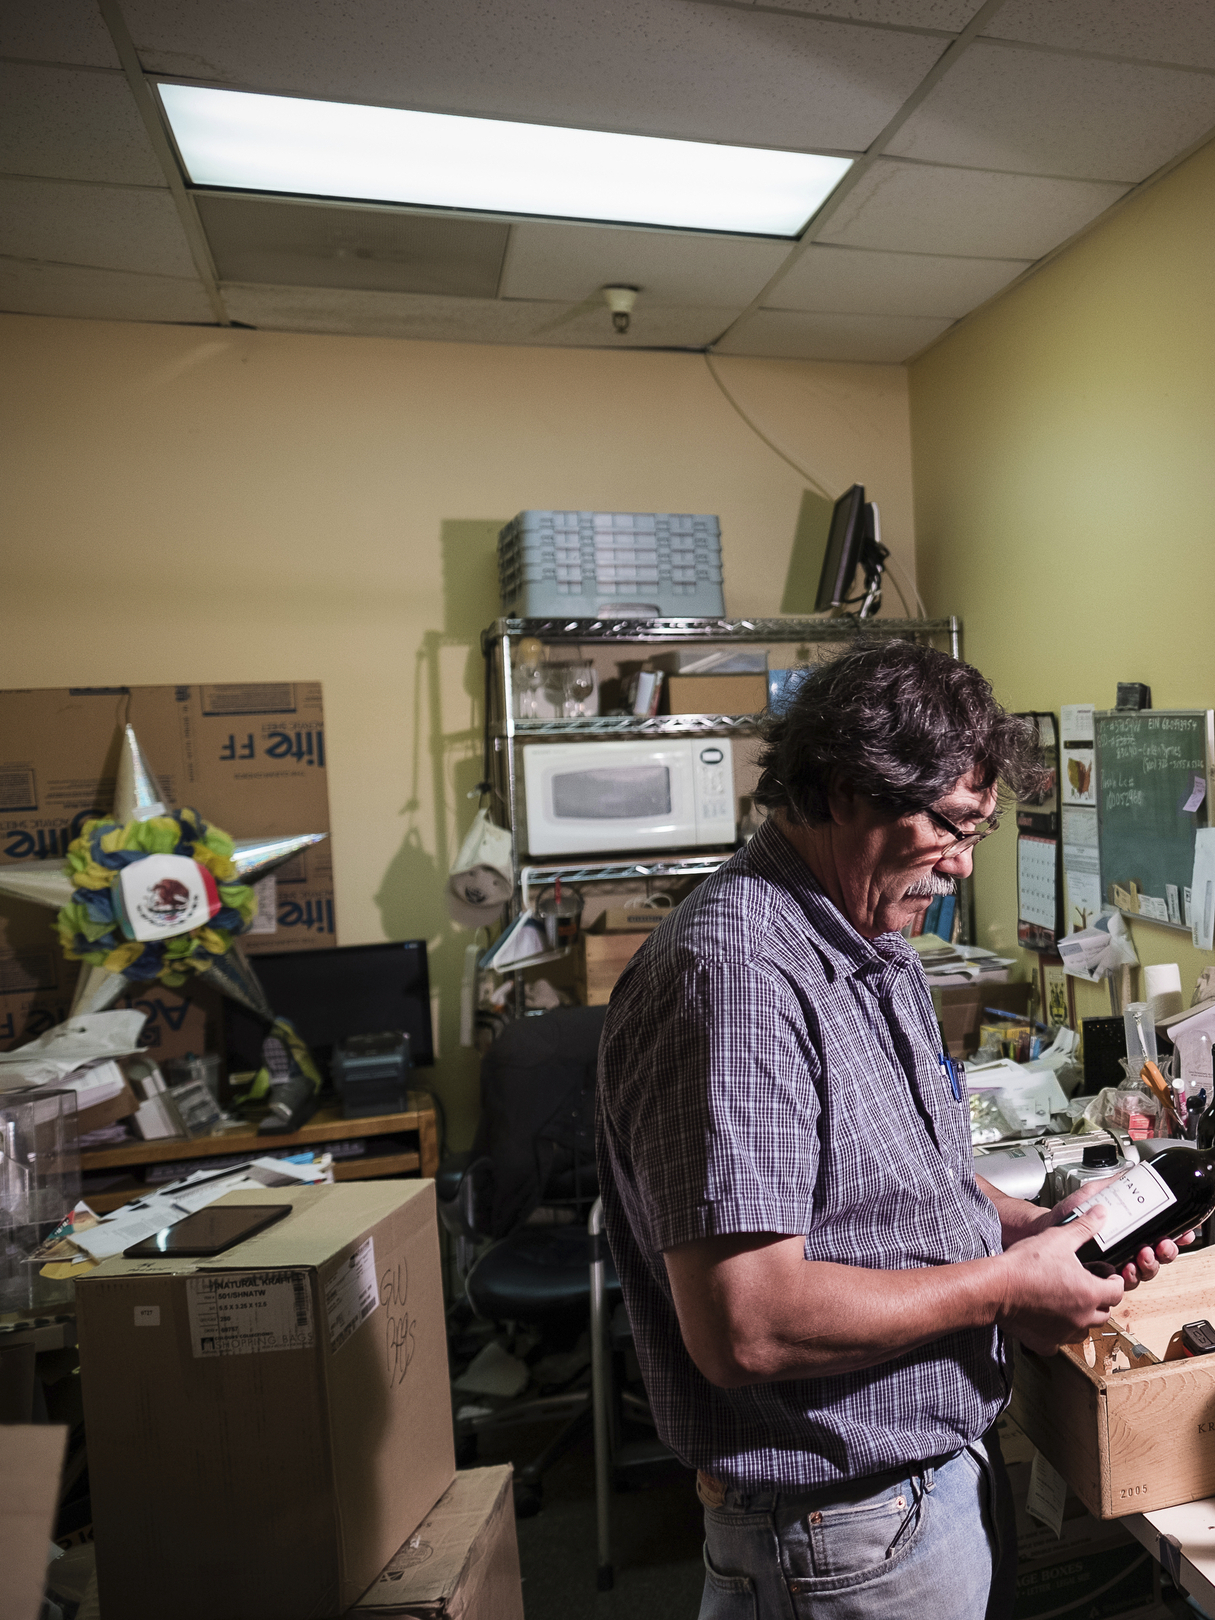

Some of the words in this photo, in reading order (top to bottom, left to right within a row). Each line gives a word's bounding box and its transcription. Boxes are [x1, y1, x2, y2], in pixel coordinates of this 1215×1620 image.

[219, 732, 257, 761] FF
[217, 1279, 260, 1290] NATURAL
[262, 1276, 291, 1286] KRAFT
[218, 1289, 266, 1299] 501/SHNATW
[215, 1336, 277, 1350] SHOPPING
[282, 1332, 314, 1344] BAGS
[1120, 1484, 1148, 1499] 2005
[1041, 1561, 1083, 1582] BOXES
